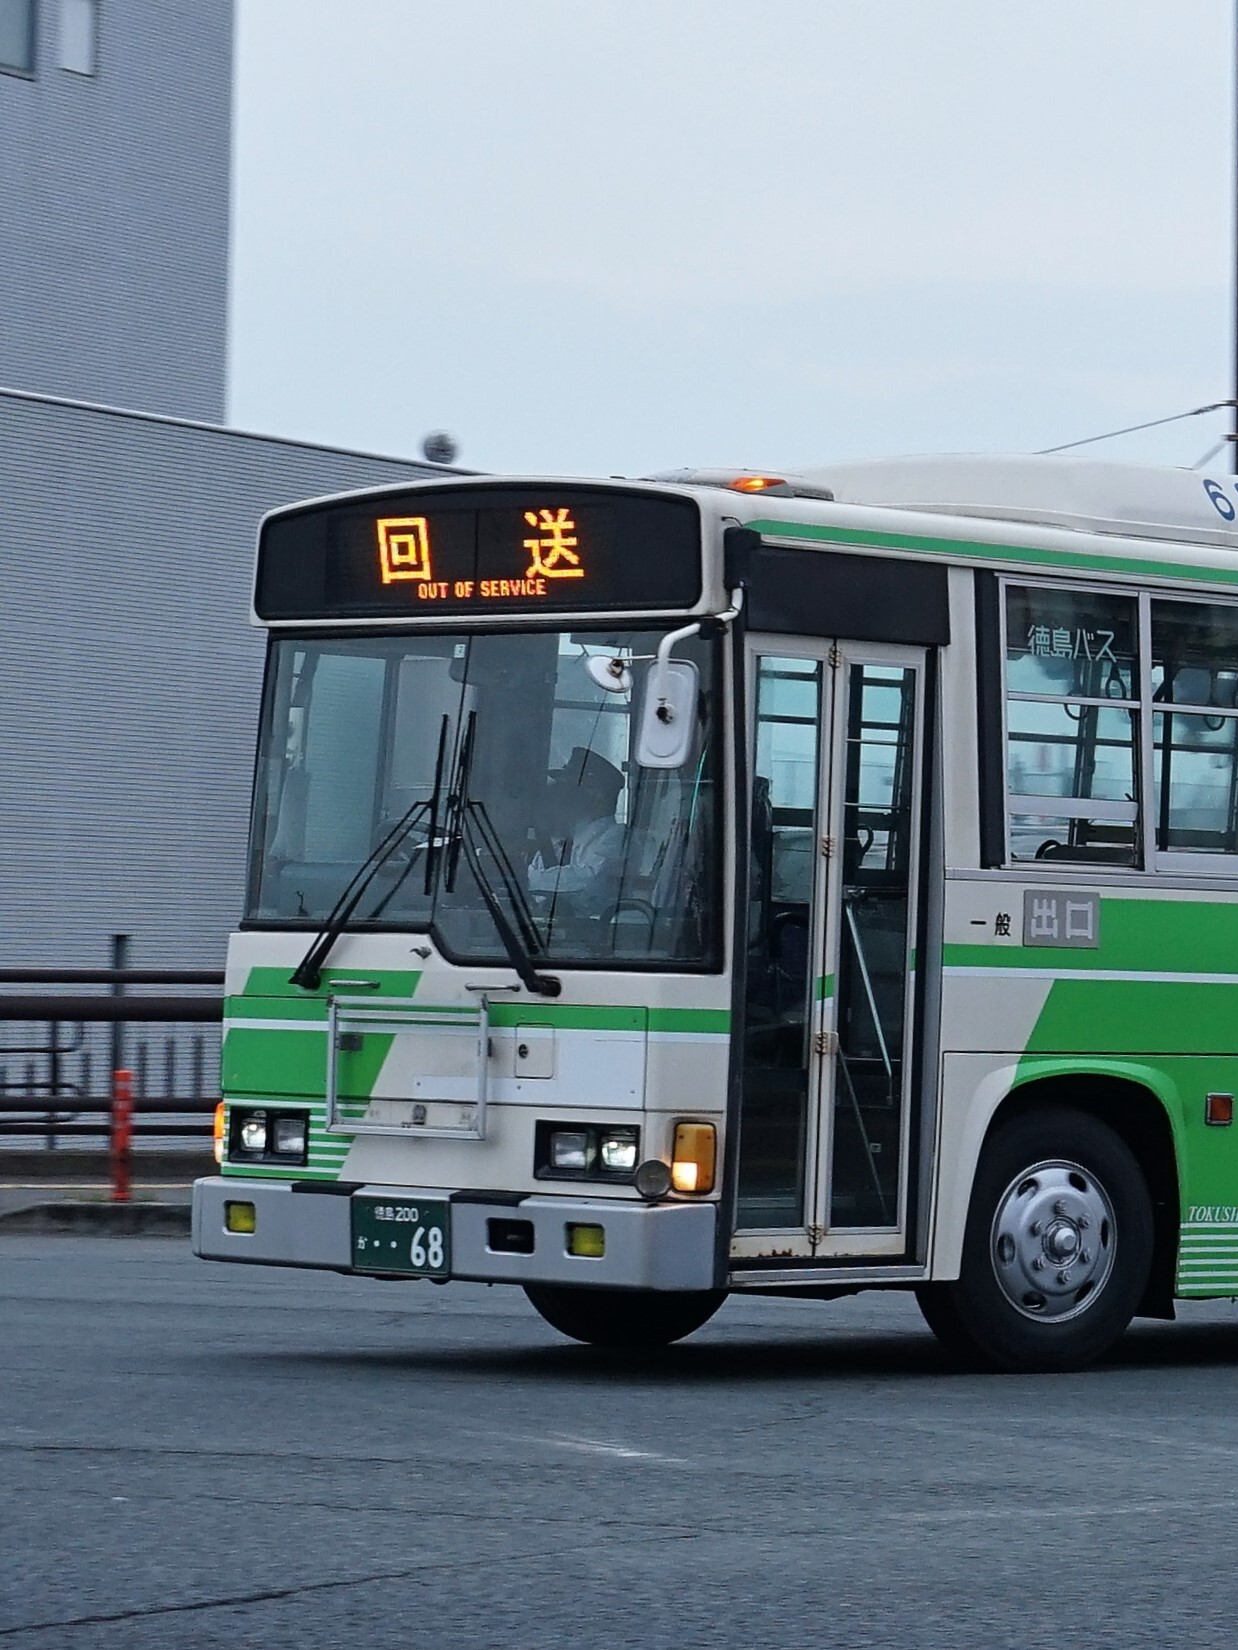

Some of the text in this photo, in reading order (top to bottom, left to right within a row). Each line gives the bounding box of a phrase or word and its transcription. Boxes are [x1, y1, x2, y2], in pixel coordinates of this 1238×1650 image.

[377, 508, 585, 584] 回送
[418, 578, 547, 599] OUT OF SERVICE
[1027, 624, 1117, 663] 徳島バス
[970, 911, 1011, 937] 一般
[1031, 898, 1093, 940] 出口
